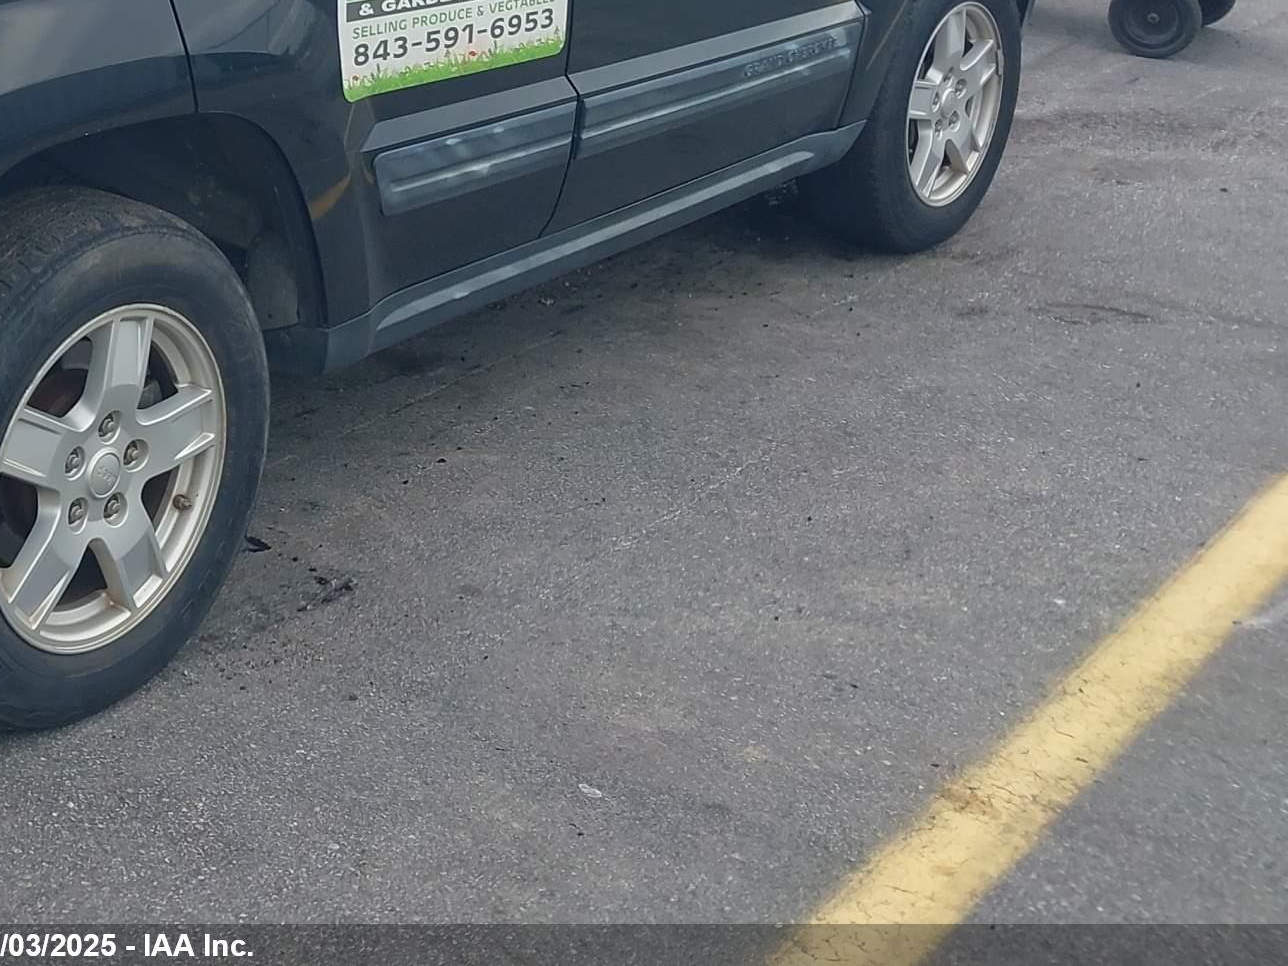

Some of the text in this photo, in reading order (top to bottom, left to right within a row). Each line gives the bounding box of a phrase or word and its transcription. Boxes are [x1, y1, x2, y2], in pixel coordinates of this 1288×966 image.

[352, 19, 408, 40] SELLING
[412, 7, 473, 29] PRODUCE
[476, 5, 485, 17] &
[359, 2, 375, 16] &
[353, 8, 554, 67] 843-591-6953
